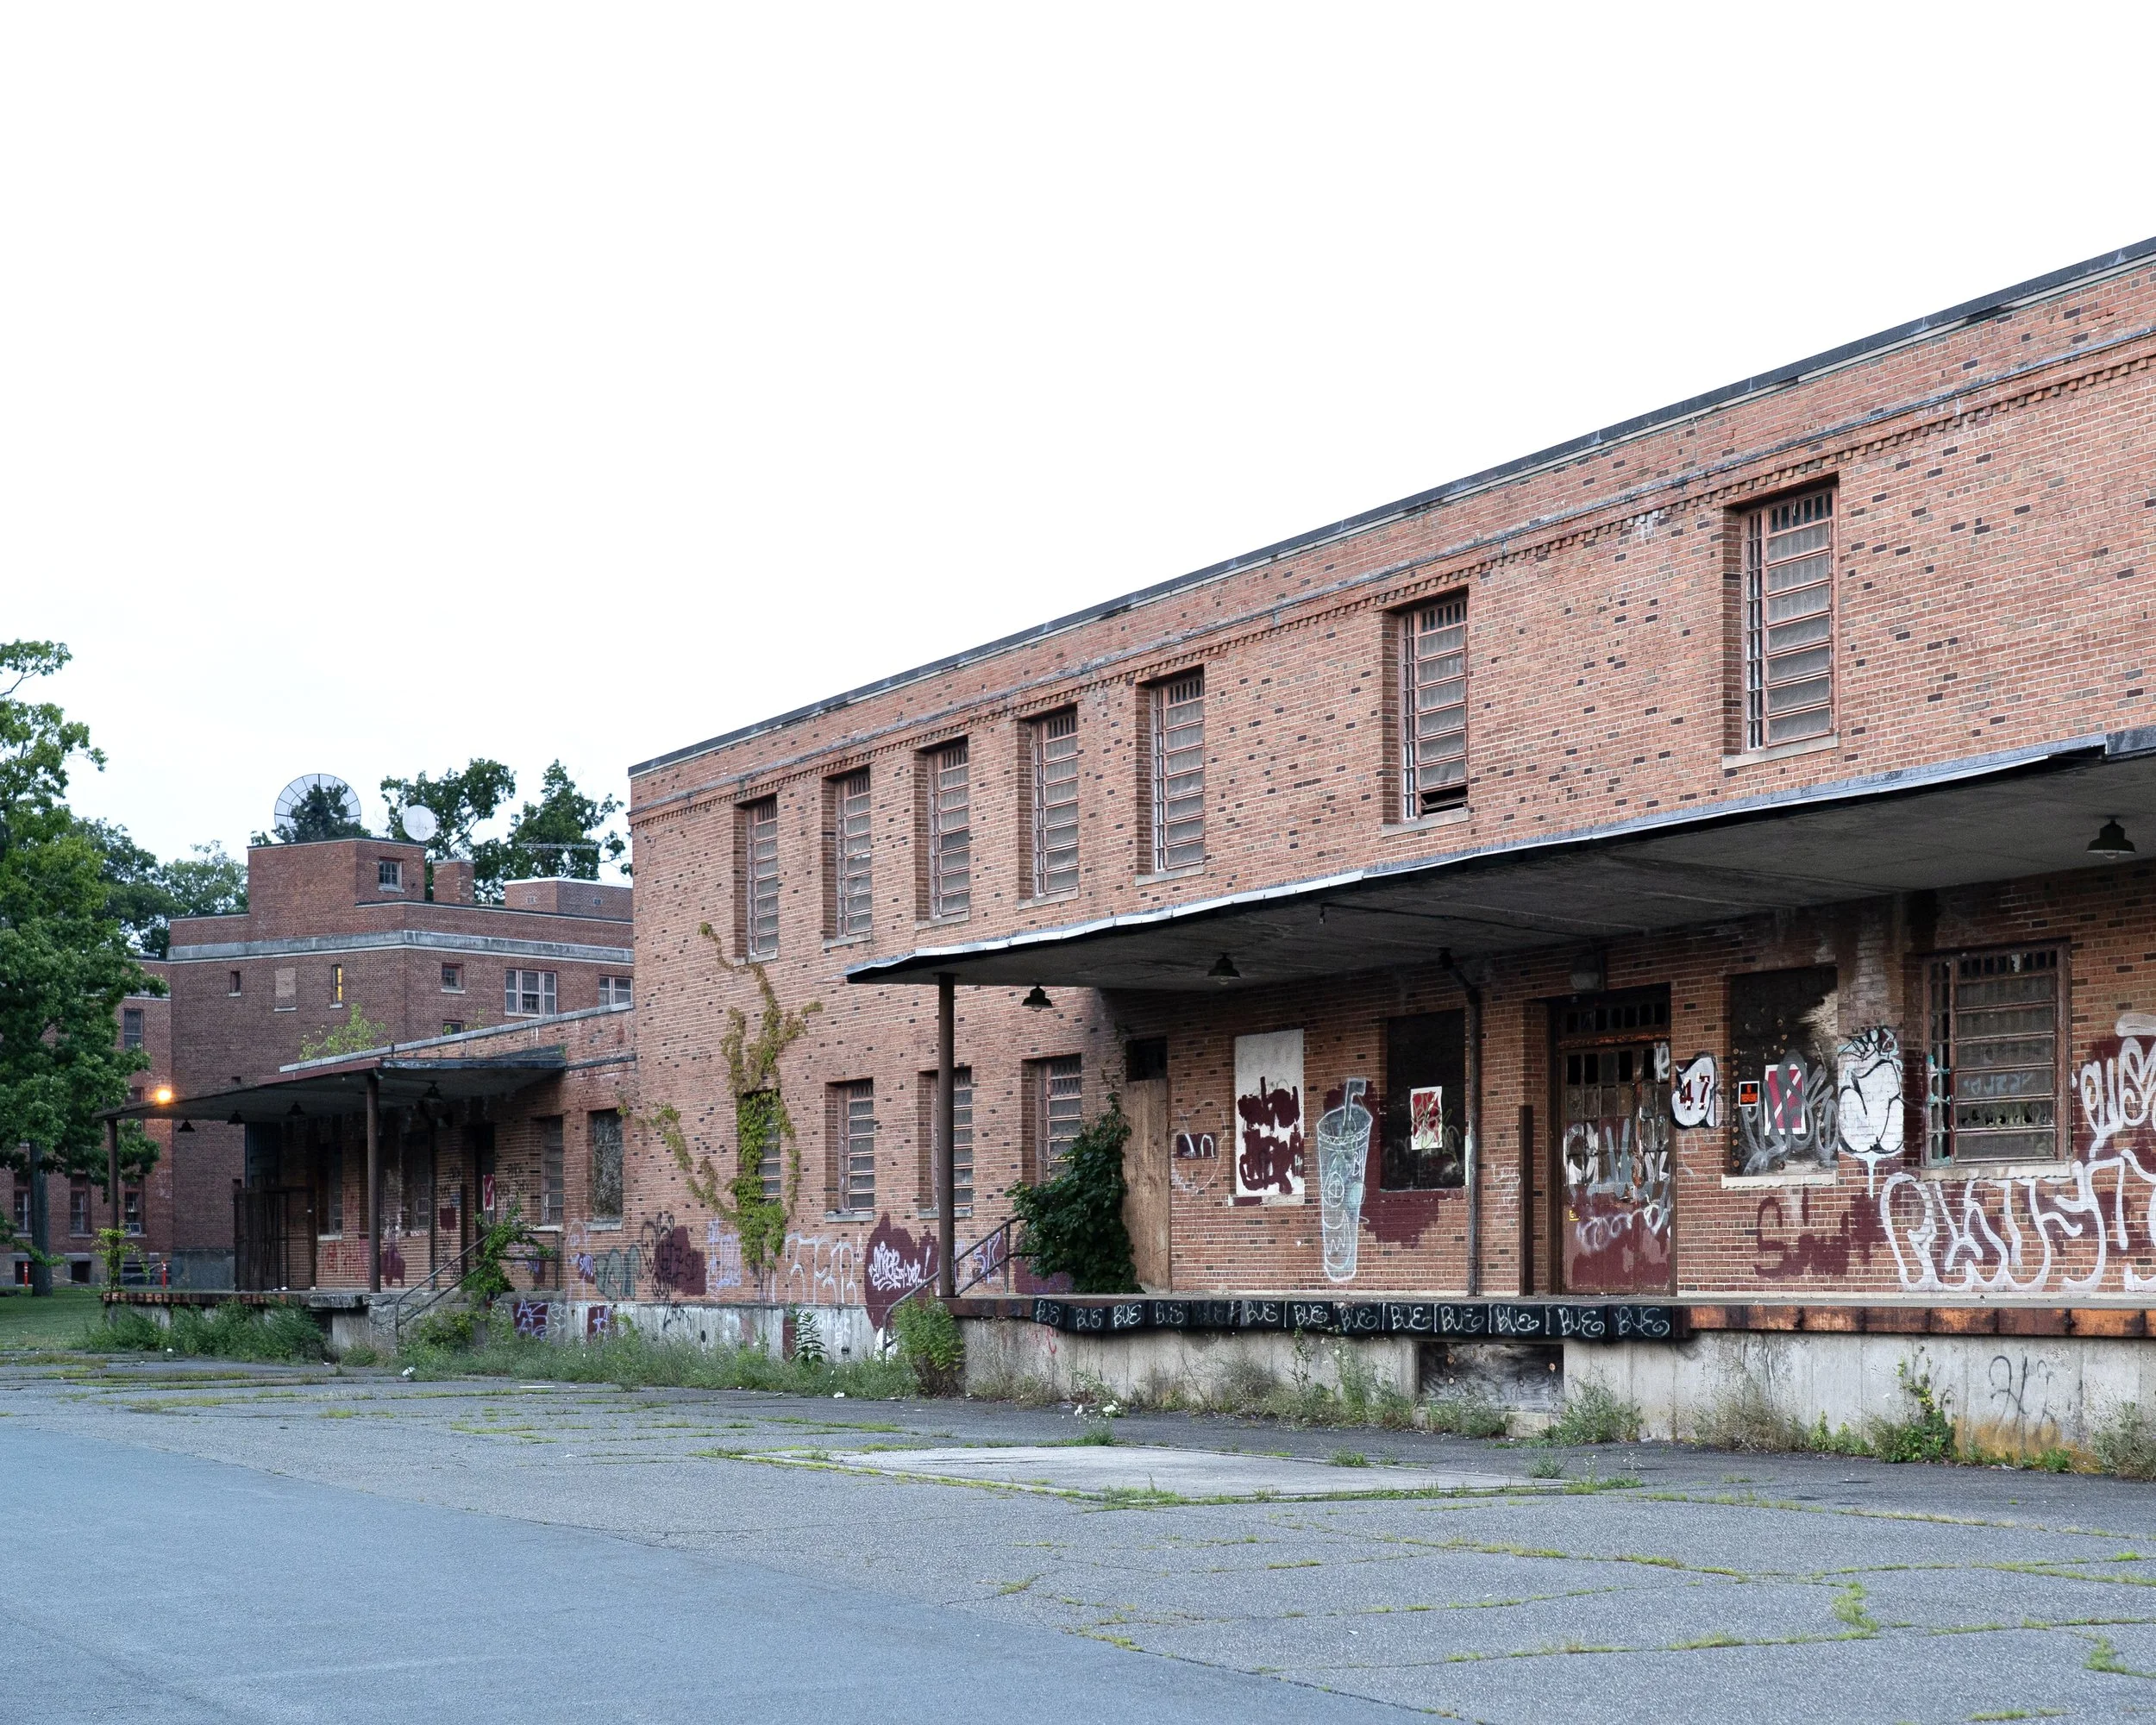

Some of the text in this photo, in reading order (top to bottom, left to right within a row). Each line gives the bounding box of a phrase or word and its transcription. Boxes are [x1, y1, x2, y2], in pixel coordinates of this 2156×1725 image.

[1076, 1308, 1103, 1330] BUE
[1113, 1303, 1142, 1327] BUE
[1246, 1301, 1279, 1324] BUE
[1294, 1303, 1329, 1327] BUE
[1340, 1308, 1377, 1333] BUE
[1390, 1304, 1432, 1331] BUE
[1440, 1306, 1485, 1333] BUE
[1495, 1304, 1540, 1333] BUE
[1558, 1306, 1605, 1338] BUE
[1614, 1306, 1670, 1337] BUE
